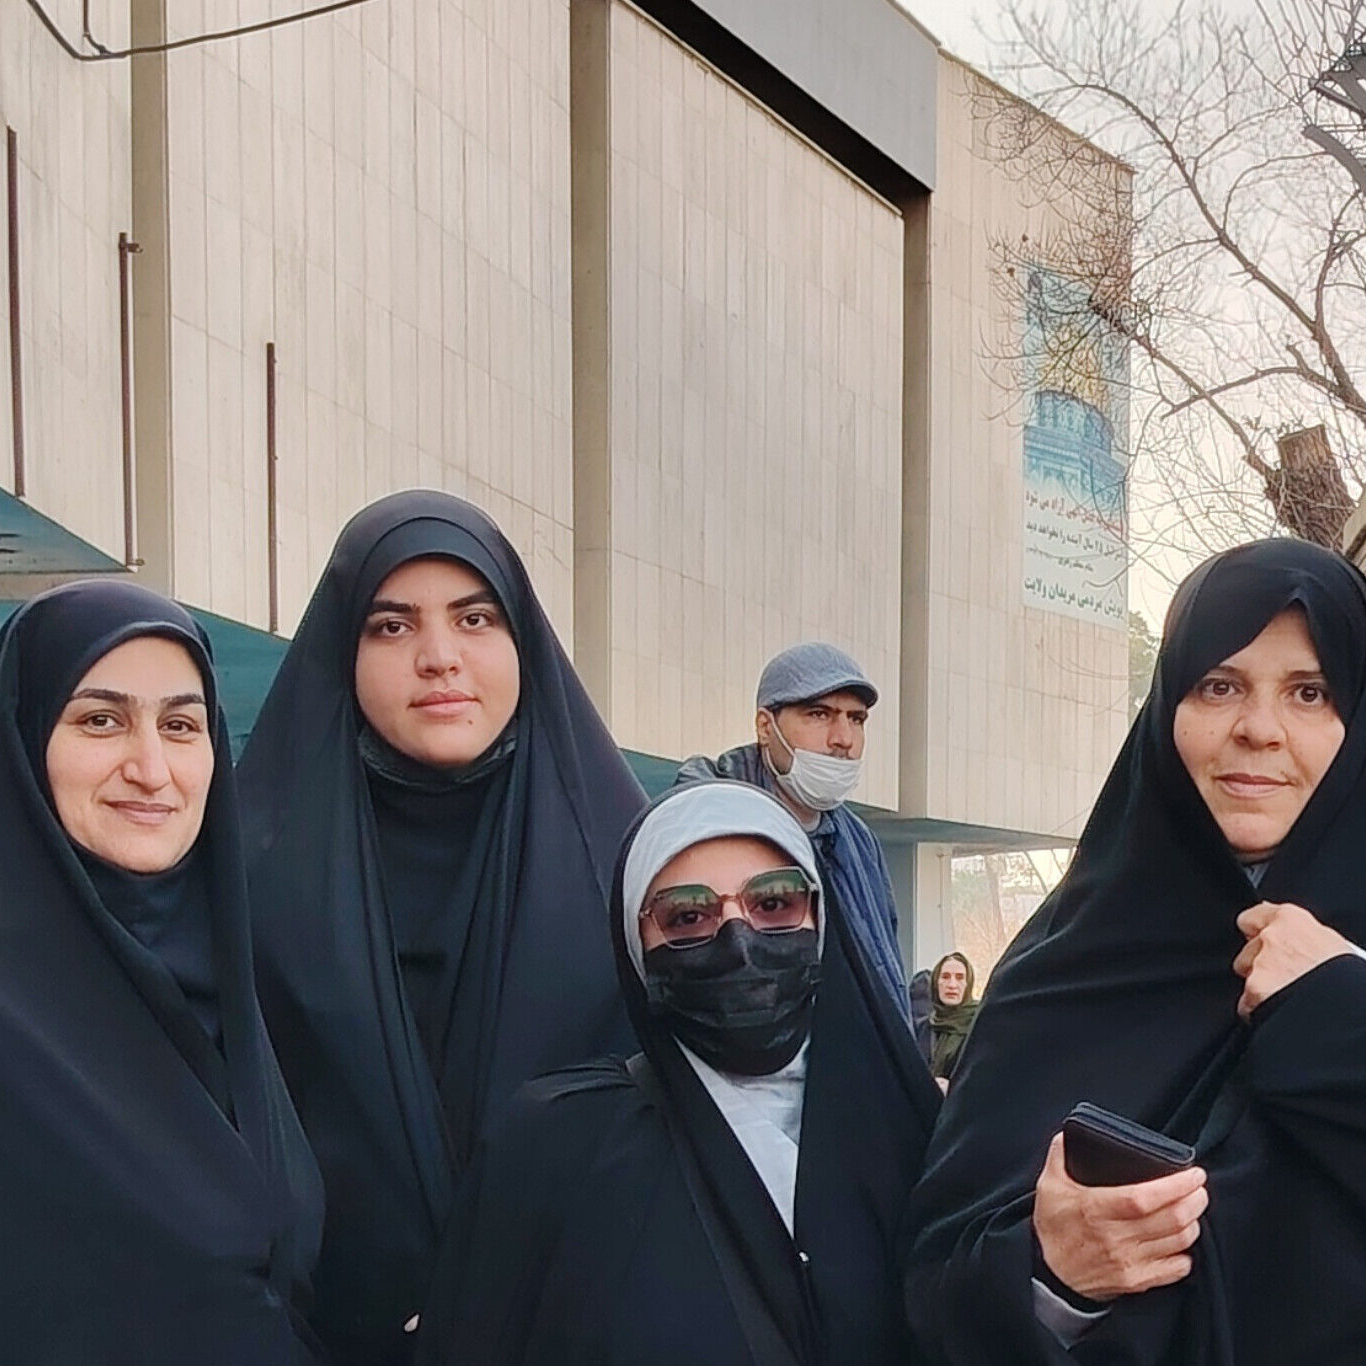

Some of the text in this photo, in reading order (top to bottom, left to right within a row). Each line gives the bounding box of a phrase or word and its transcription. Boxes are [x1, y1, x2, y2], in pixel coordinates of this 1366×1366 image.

[1024, 577, 1124, 619] پویش مردمی مریدان ولایت
